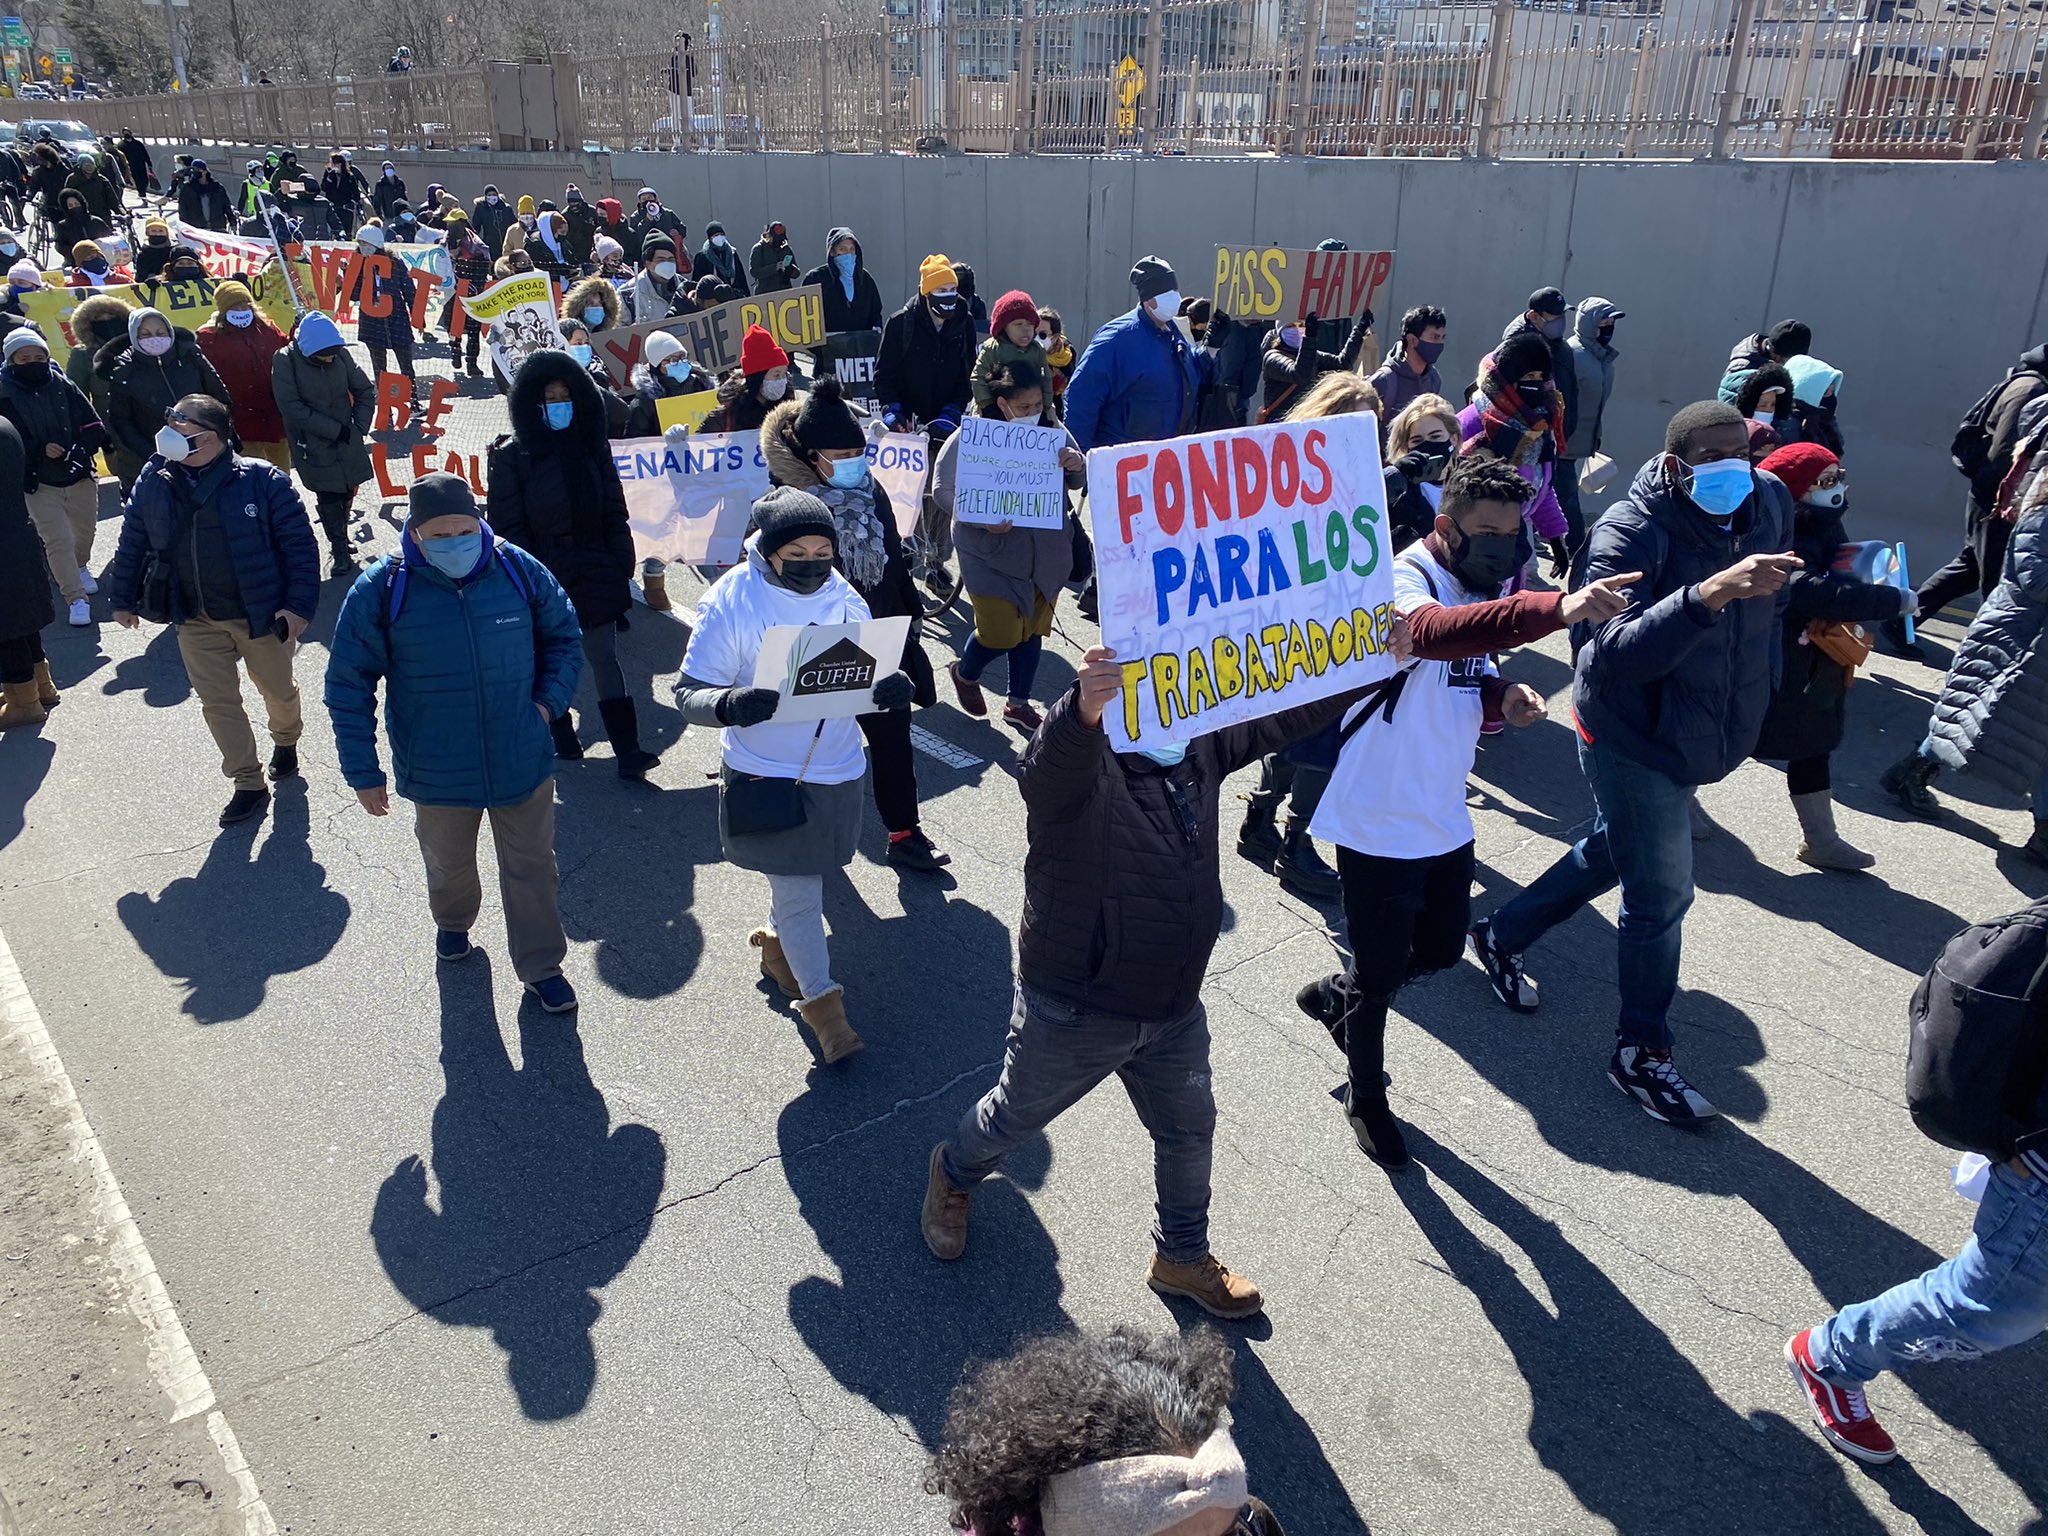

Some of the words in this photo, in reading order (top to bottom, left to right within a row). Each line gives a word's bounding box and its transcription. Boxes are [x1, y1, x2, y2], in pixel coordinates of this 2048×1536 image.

[475, 296, 499, 313] MAKE
[498, 286, 517, 301] THE
[516, 281, 545, 293] ROAD
[506, 293, 525, 306] NEW
[526, 290, 546, 299] YORK
[1213, 246, 1287, 317] PASS
[1297, 250, 1392, 320] HAVP
[651, 308, 737, 369] HE
[960, 418, 1060, 454] BLACKROCK
[613, 445, 743, 480] ENANTS
[961, 452, 980, 464] YOU
[982, 455, 1001, 466] ARE
[1005, 458, 1057, 470] COMPLICIT
[994, 470, 1015, 485] YOU
[1016, 471, 1054, 486] MUST
[1115, 429, 1333, 545] FONDOS
[957, 488, 1061, 518] #DEFUNDPALENTIR
[1152, 526, 1292, 627] PARA
[1291, 504, 1381, 587] LOS
[800, 665, 872, 688] CUFFH
